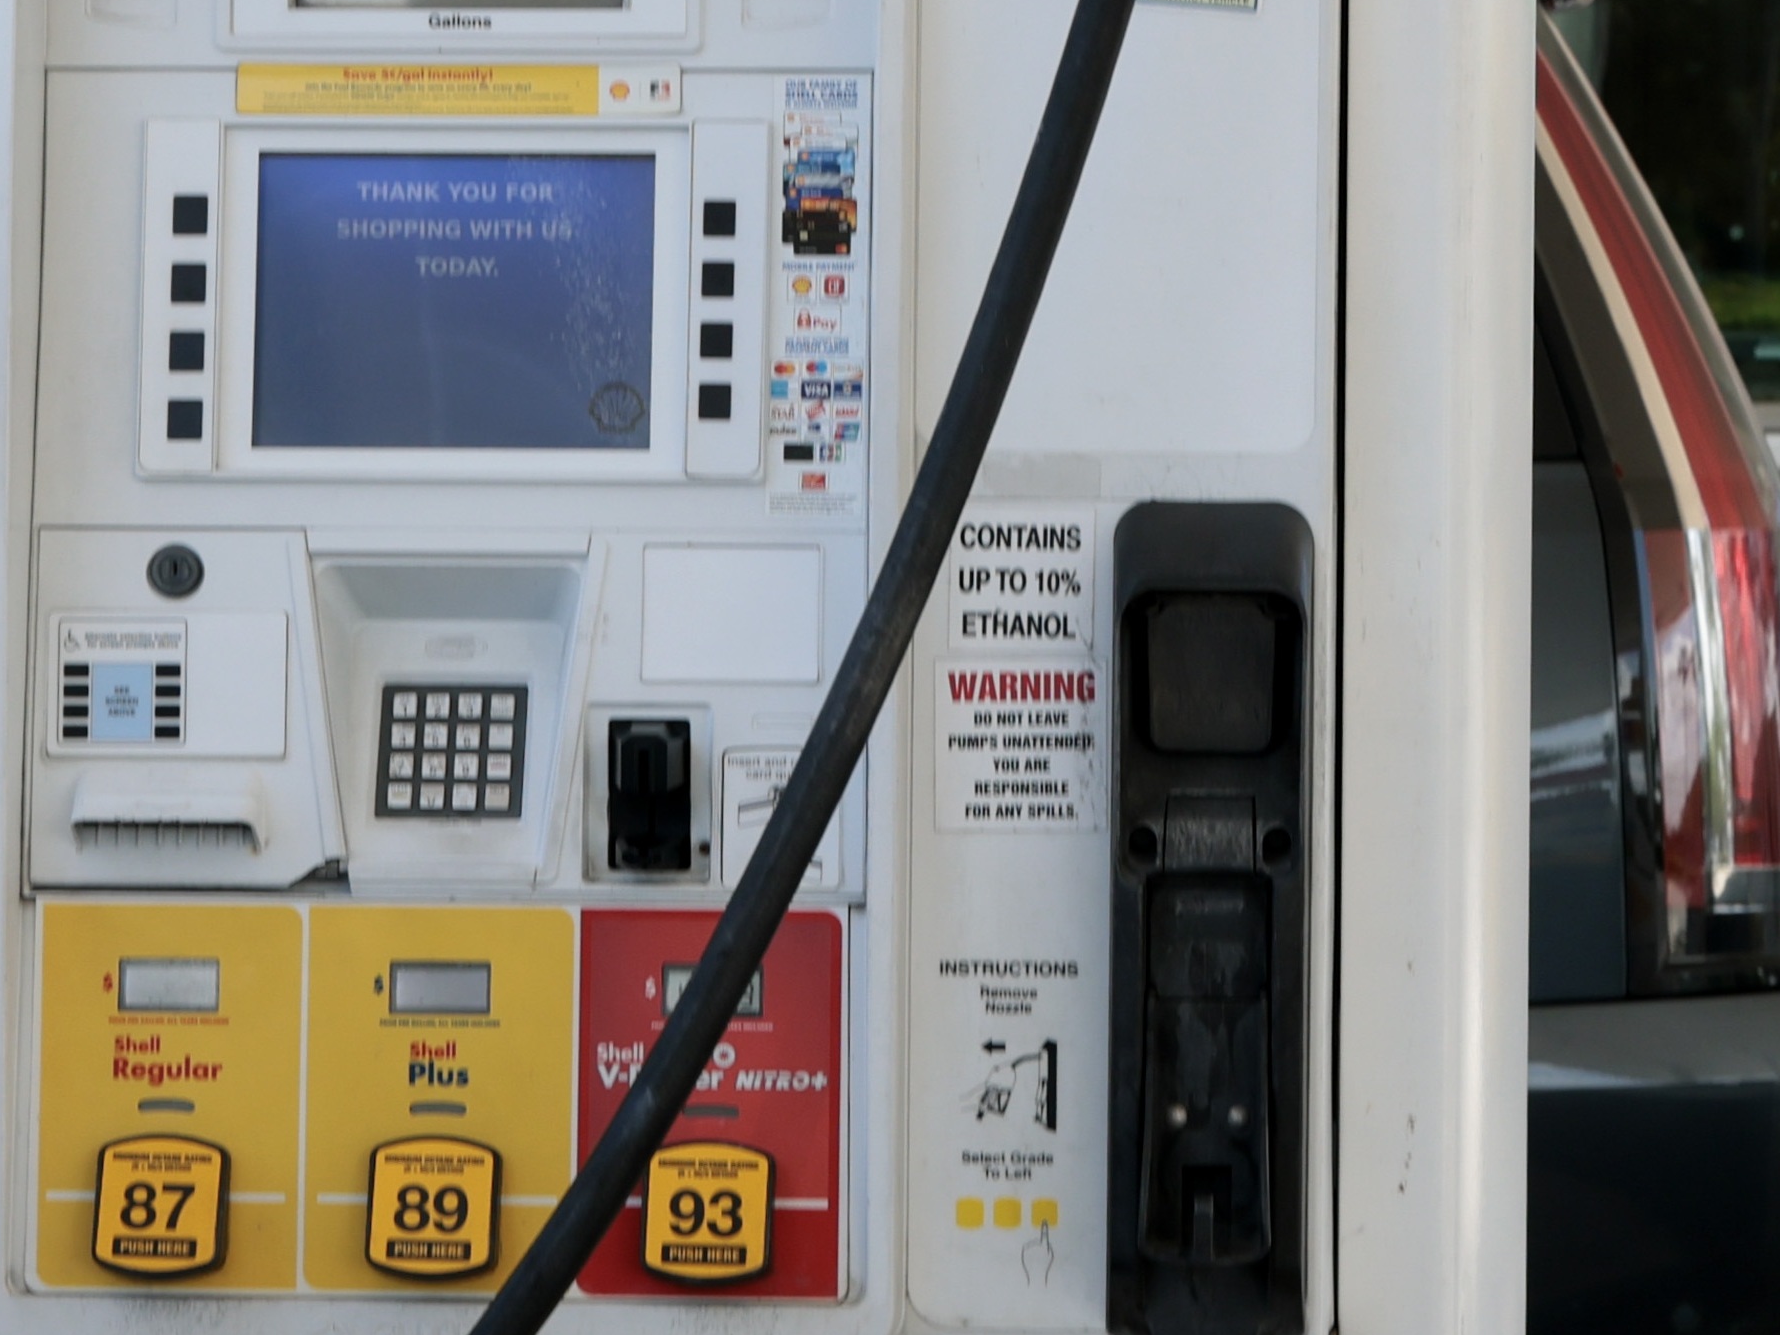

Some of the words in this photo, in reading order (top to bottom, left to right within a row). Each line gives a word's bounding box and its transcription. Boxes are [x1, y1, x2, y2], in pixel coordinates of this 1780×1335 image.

[428, 13, 492, 30] Gallons
[357, 181, 440, 203] THANK
[448, 181, 497, 203] YOU
[506, 181, 553, 203] FOR
[336, 219, 463, 242] SHOPPING
[469, 219, 534, 242] WITH
[541, 218, 572, 242] US
[415, 256, 499, 278] TODAY.
[960, 523, 1082, 551] CONTAINS
[958, 568, 991, 593] UP
[999, 569, 1027, 593] TO
[1036, 570, 1081, 595] 10%
[962, 612, 1076, 640] ETHANOL
[948, 670, 1096, 704] WARNING
[973, 711, 992, 727] DO
[996, 711, 1024, 727] NOT
[1028, 712, 1070, 727] LEAVE
[948, 734, 998, 750] PUMPS
[993, 757, 1020, 773] YOU
[1024, 758, 1051, 773] ARE
[974, 780, 1070, 796] RESPONSIBLE
[965, 803, 991, 819] FOR
[995, 803, 1023, 819] ANY
[939, 959, 1079, 978] INSTRUCTIONS
[980, 985, 1038, 1000] Remove
[985, 1002, 1032, 1016] Nozzle
[114, 1035, 161, 1054] Shell
[410, 1040, 457, 1060] Shell
[596, 1041, 644, 1063] Shell
[113, 1054, 223, 1087] Regular
[408, 1061, 470, 1087] Plus
[735, 1070, 828, 1092] NITRO+
[961, 1150, 1007, 1165] Select
[1010, 1151, 1054, 1165] Grade
[984, 1167, 1001, 1180] To
[1004, 1168, 1033, 1181] Left
[119, 1180, 197, 1232] 87
[393, 1184, 470, 1234] 89
[668, 1187, 744, 1239] 93
[120, 1240, 154, 1255] PUSH
[158, 1241, 191, 1256] HERE
[394, 1242, 428, 1257] PUSH
[432, 1243, 465, 1258] HERE
[669, 1247, 703, 1262] PUSH
[708, 1247, 740, 1263] HERE
